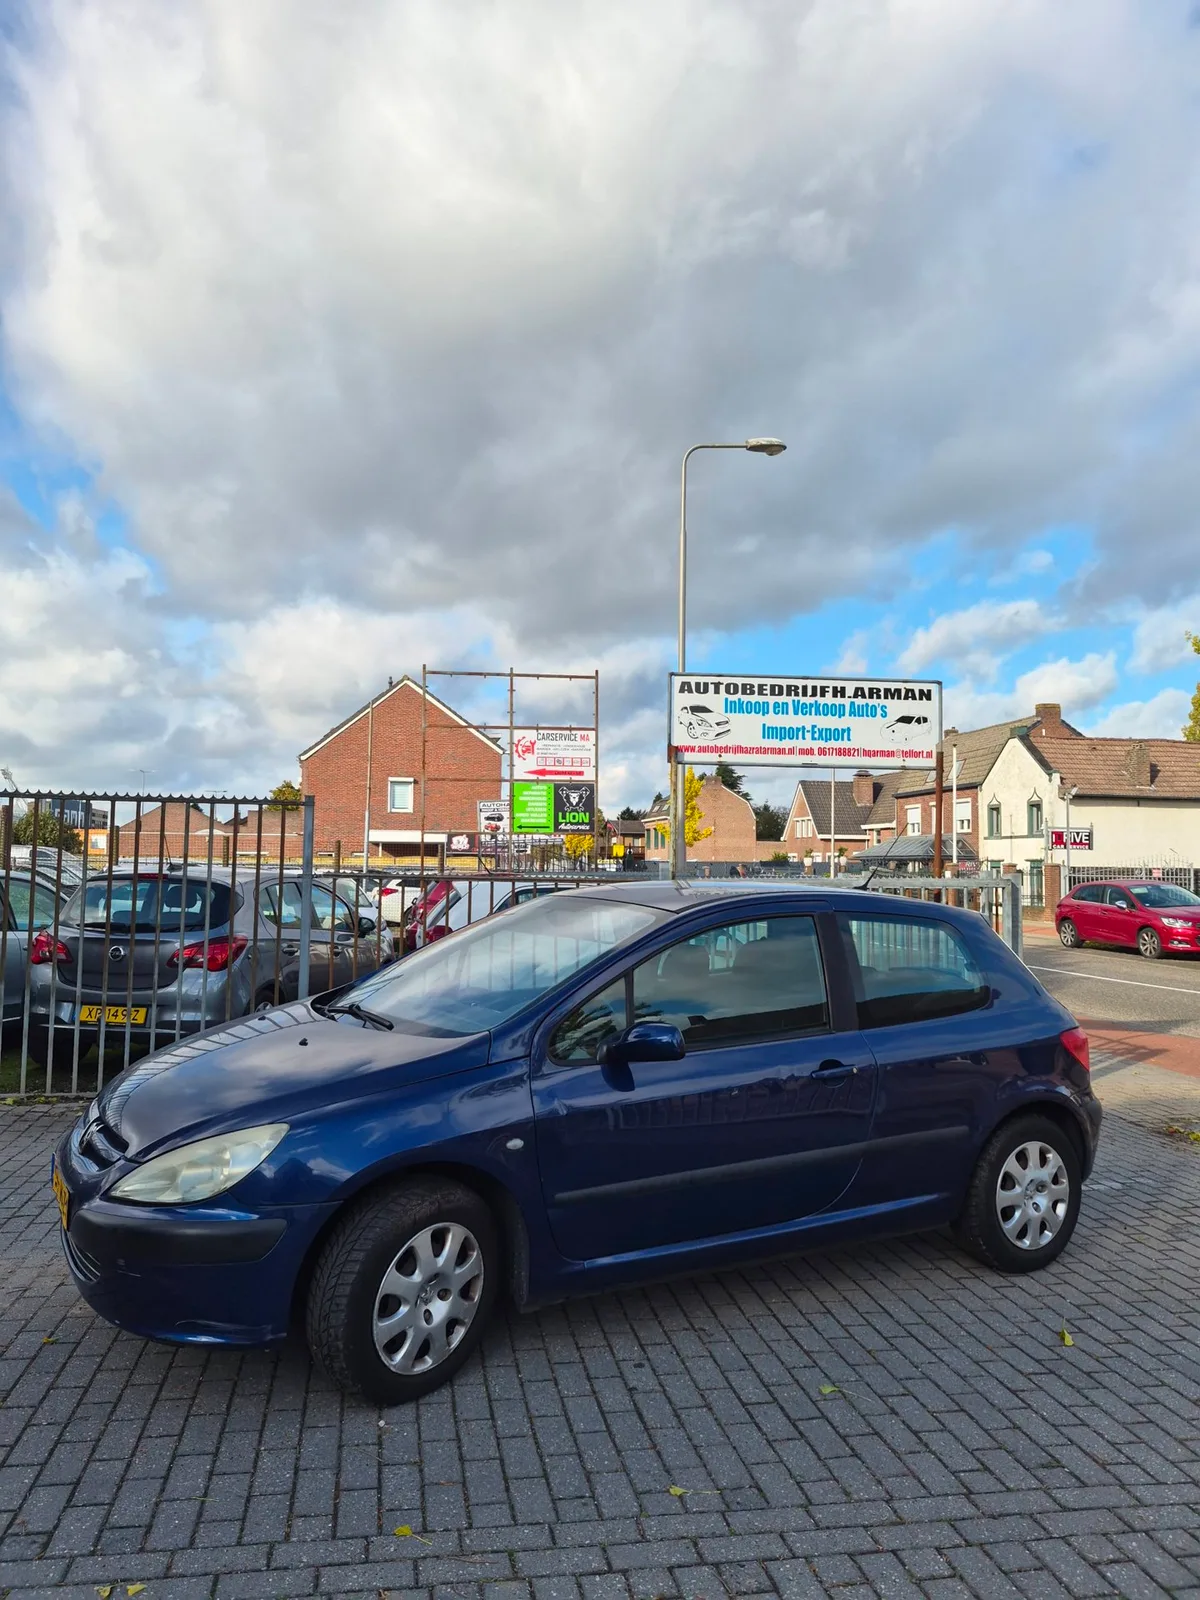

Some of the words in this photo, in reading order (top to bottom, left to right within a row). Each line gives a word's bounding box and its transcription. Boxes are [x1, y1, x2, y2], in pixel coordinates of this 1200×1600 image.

[678, 680, 932, 701] AUTOBEDRIJFH.ARMAN
[724, 697, 770, 716] Inkoop
[773, 701, 789, 715] en
[792, 699, 846, 719] Verkoop
[849, 701, 888, 718] Auto's
[536, 732, 578, 742] CARSERVICE
[580, 733, 590, 742] MA
[762, 723, 851, 743] Import-Export
[798, 746, 816, 756] mob.
[817, 747, 860, 757] 0617188821
[558, 811, 590, 823] LION
